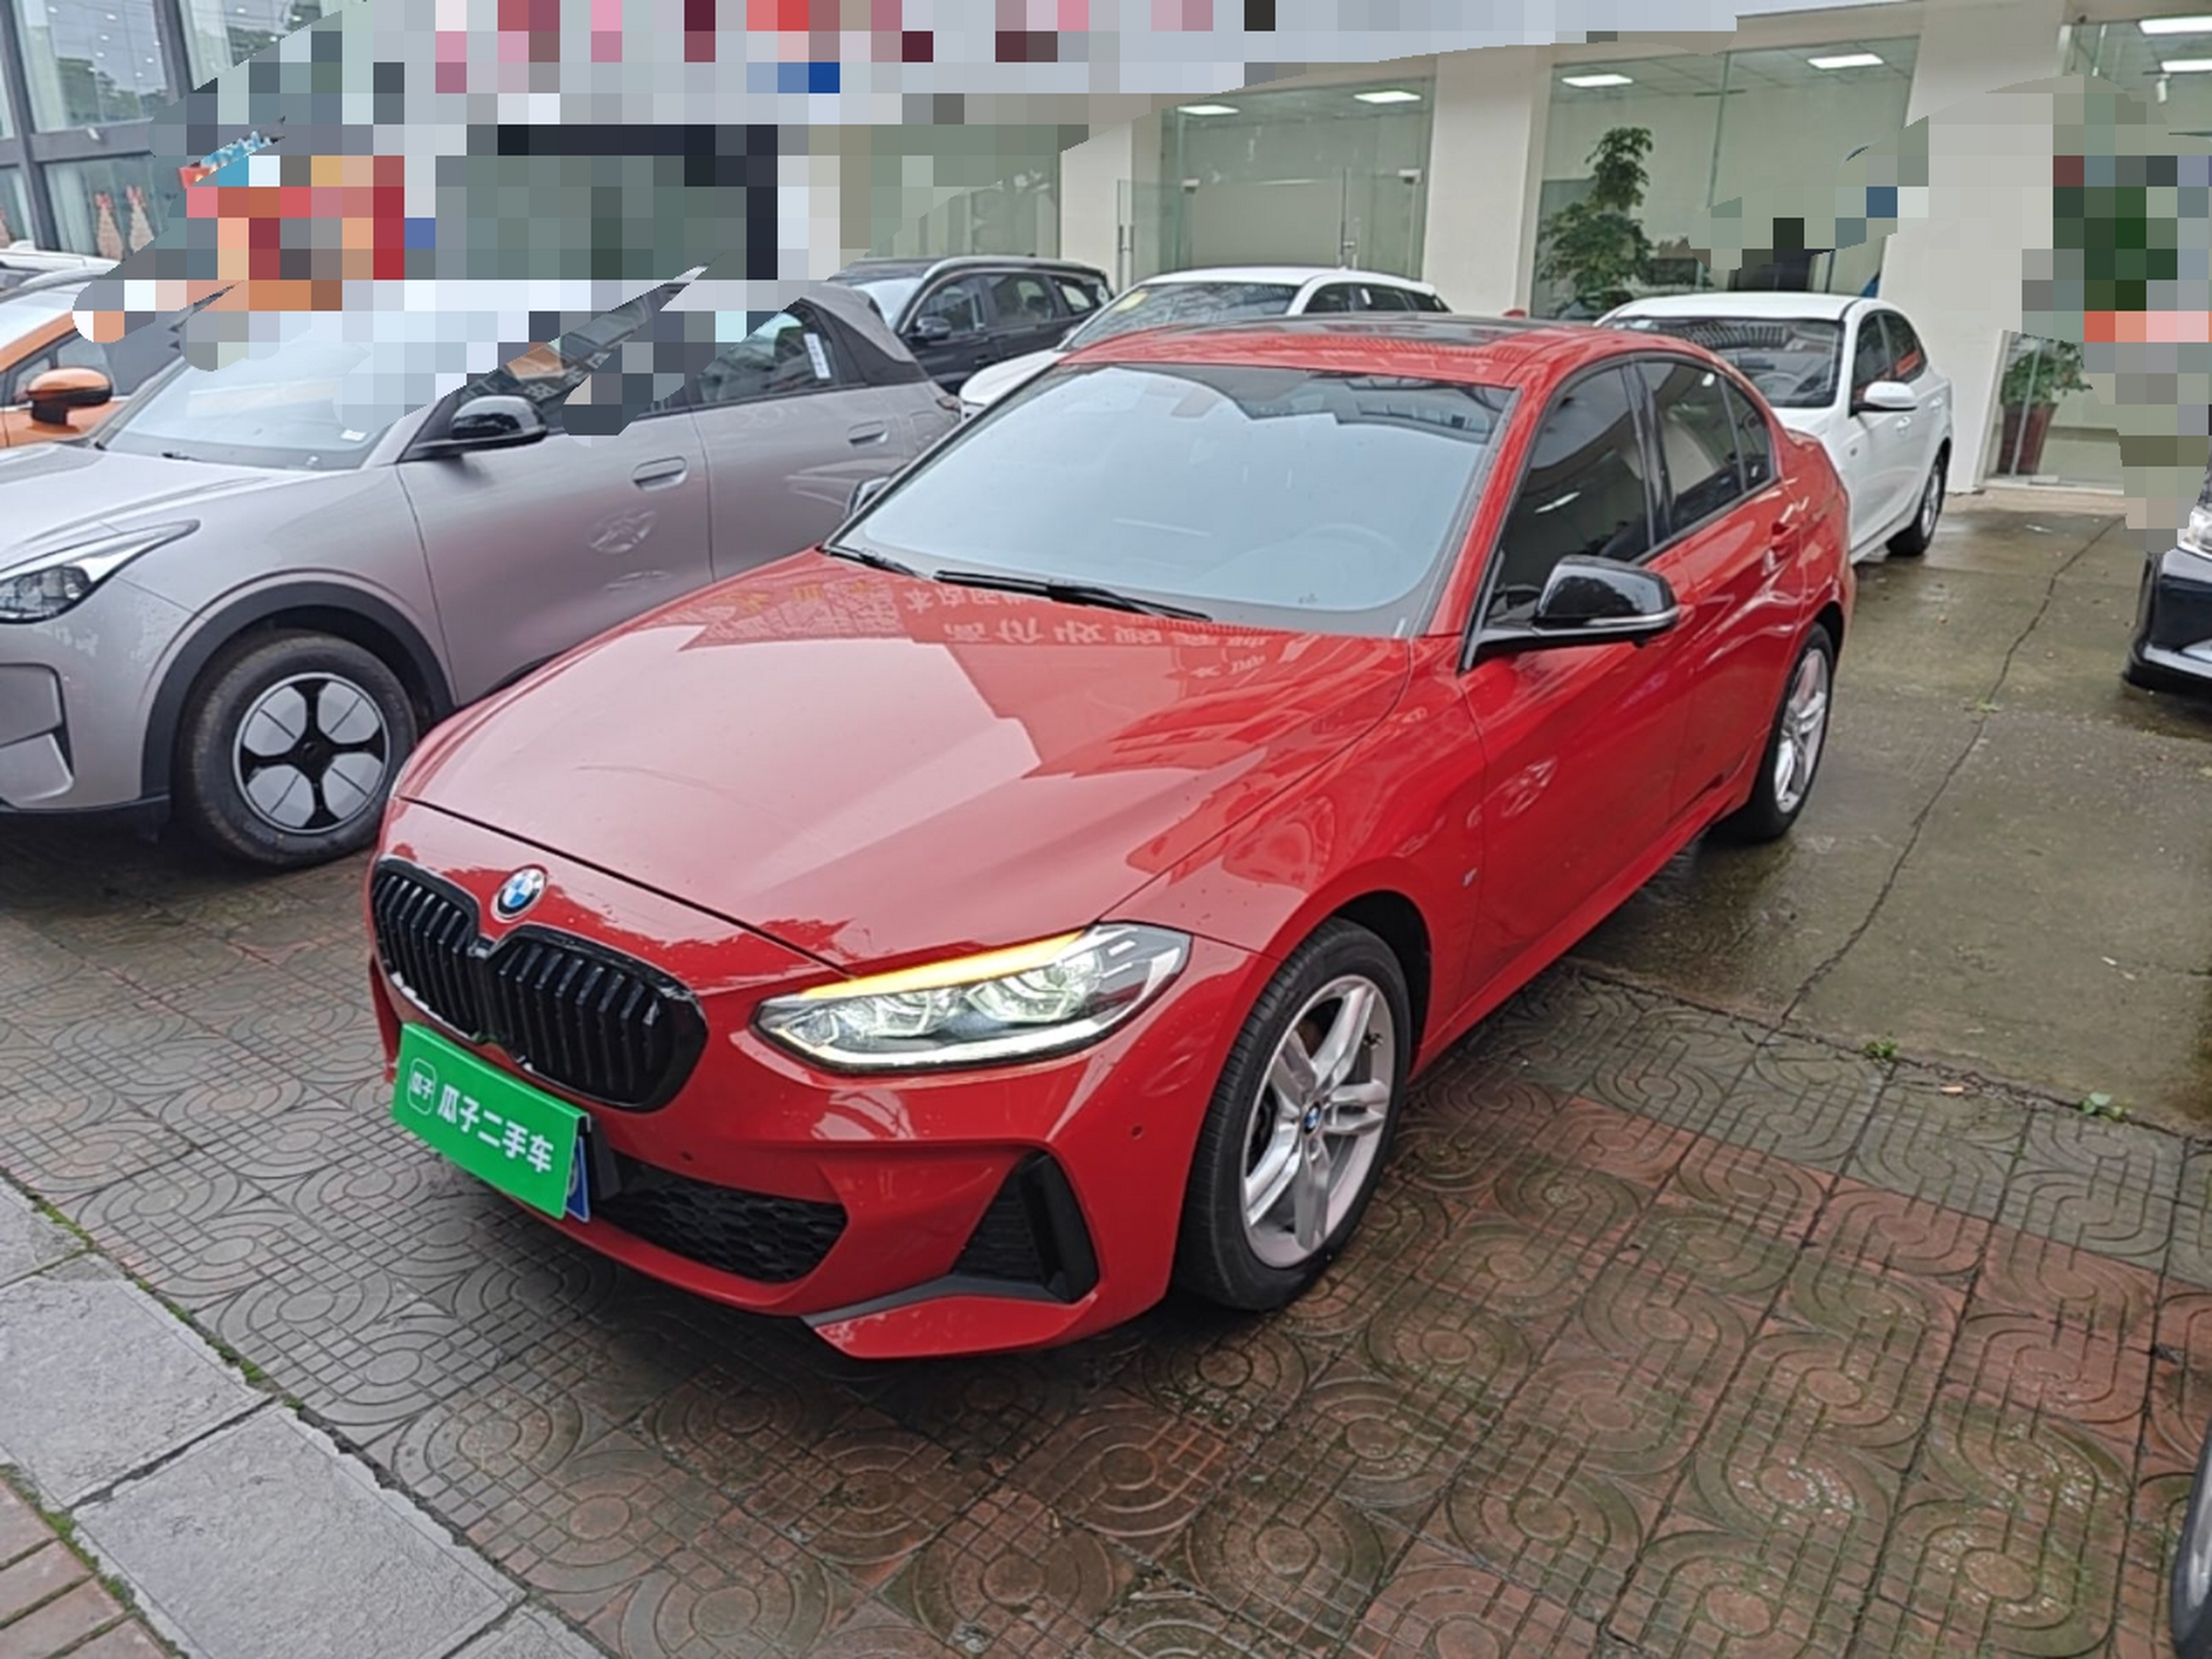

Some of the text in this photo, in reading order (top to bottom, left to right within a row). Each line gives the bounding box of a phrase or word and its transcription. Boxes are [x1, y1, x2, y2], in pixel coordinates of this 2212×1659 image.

[437, 1083, 554, 1173] 瓜子二手车
